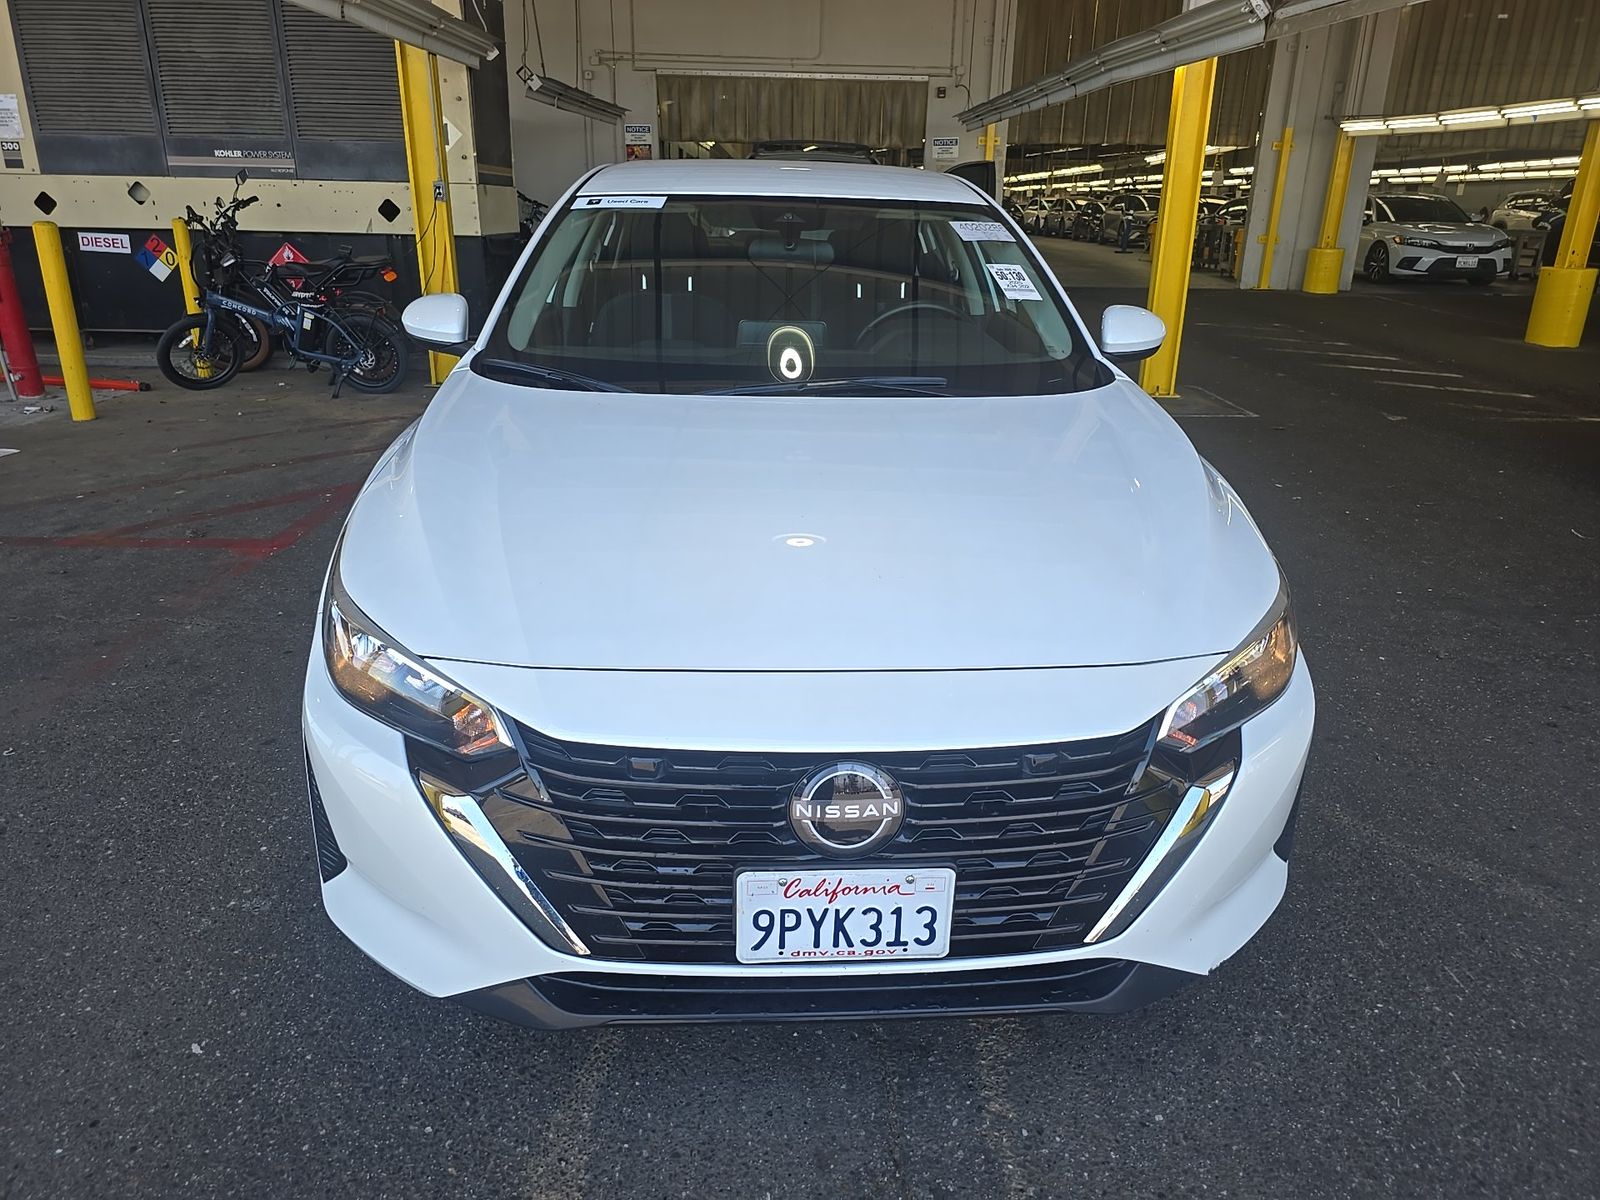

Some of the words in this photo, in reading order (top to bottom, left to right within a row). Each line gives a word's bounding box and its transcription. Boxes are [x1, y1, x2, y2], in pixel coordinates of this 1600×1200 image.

[2, 142, 19, 150] 300
[214, 149, 242, 157] KOHLER
[243, 150, 267, 158] POWER
[81, 236, 128, 249] DIESEL
[151, 237, 162, 253] 2
[165, 251, 175, 266] 0
[995, 271, 1026, 281] 50:130
[222, 300, 257, 315] CONCORD
[796, 801, 898, 818] NISSAN
[783, 878, 915, 904] California
[751, 905, 938, 951] 9PYK313
[790, 949, 897, 958] dmv.ca.gov
